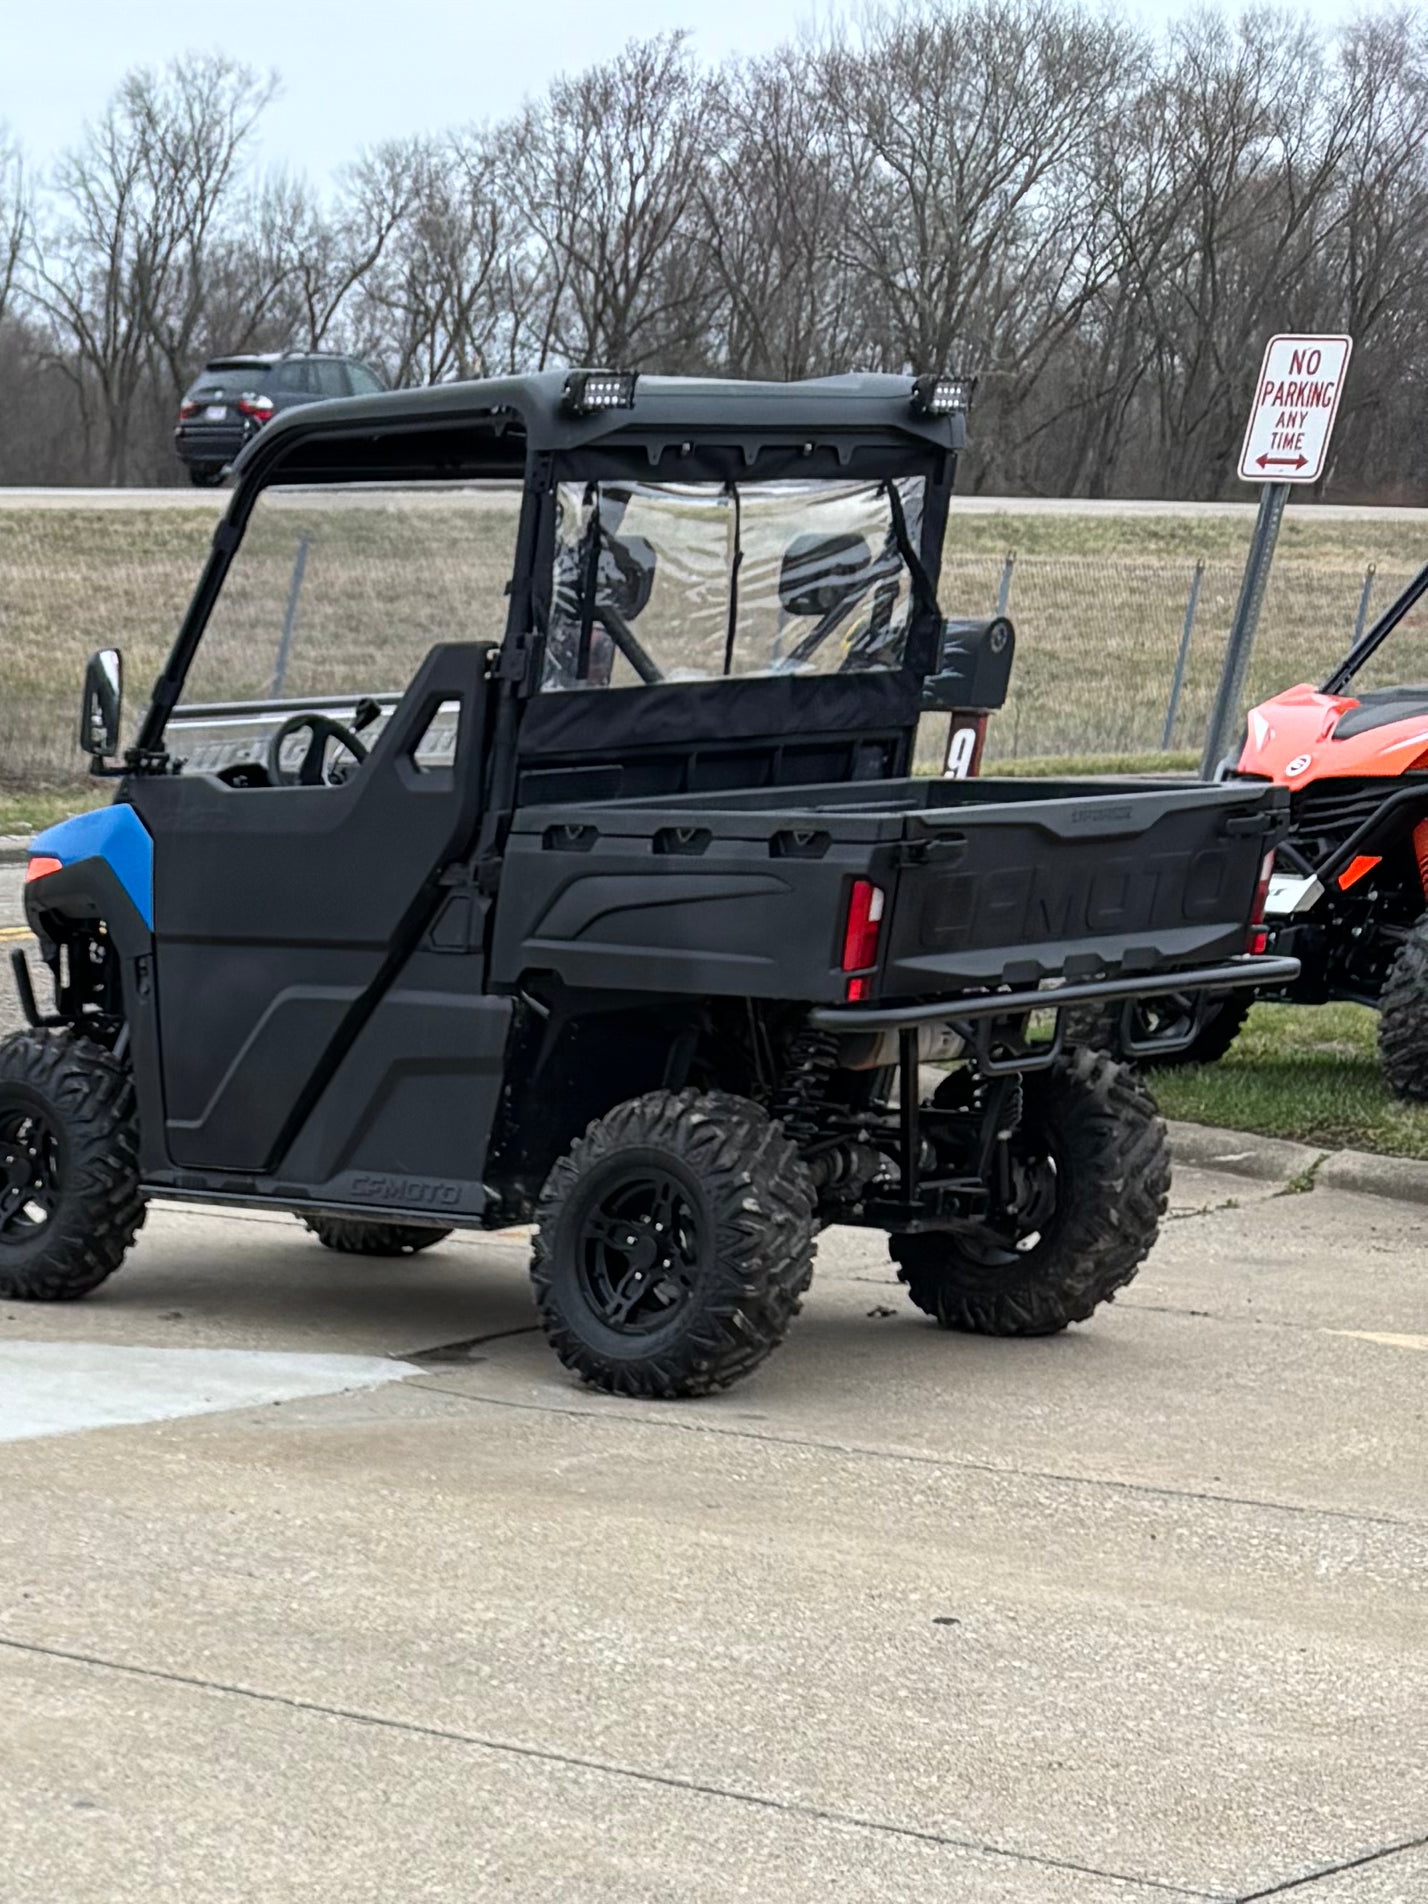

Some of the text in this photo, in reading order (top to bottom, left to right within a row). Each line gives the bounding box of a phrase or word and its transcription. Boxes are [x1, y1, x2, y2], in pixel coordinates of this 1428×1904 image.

[1288, 349, 1322, 376] NO
[1260, 381, 1335, 409] PARKING
[1274, 411, 1309, 430] ANY
[1270, 432, 1305, 451] TIME
